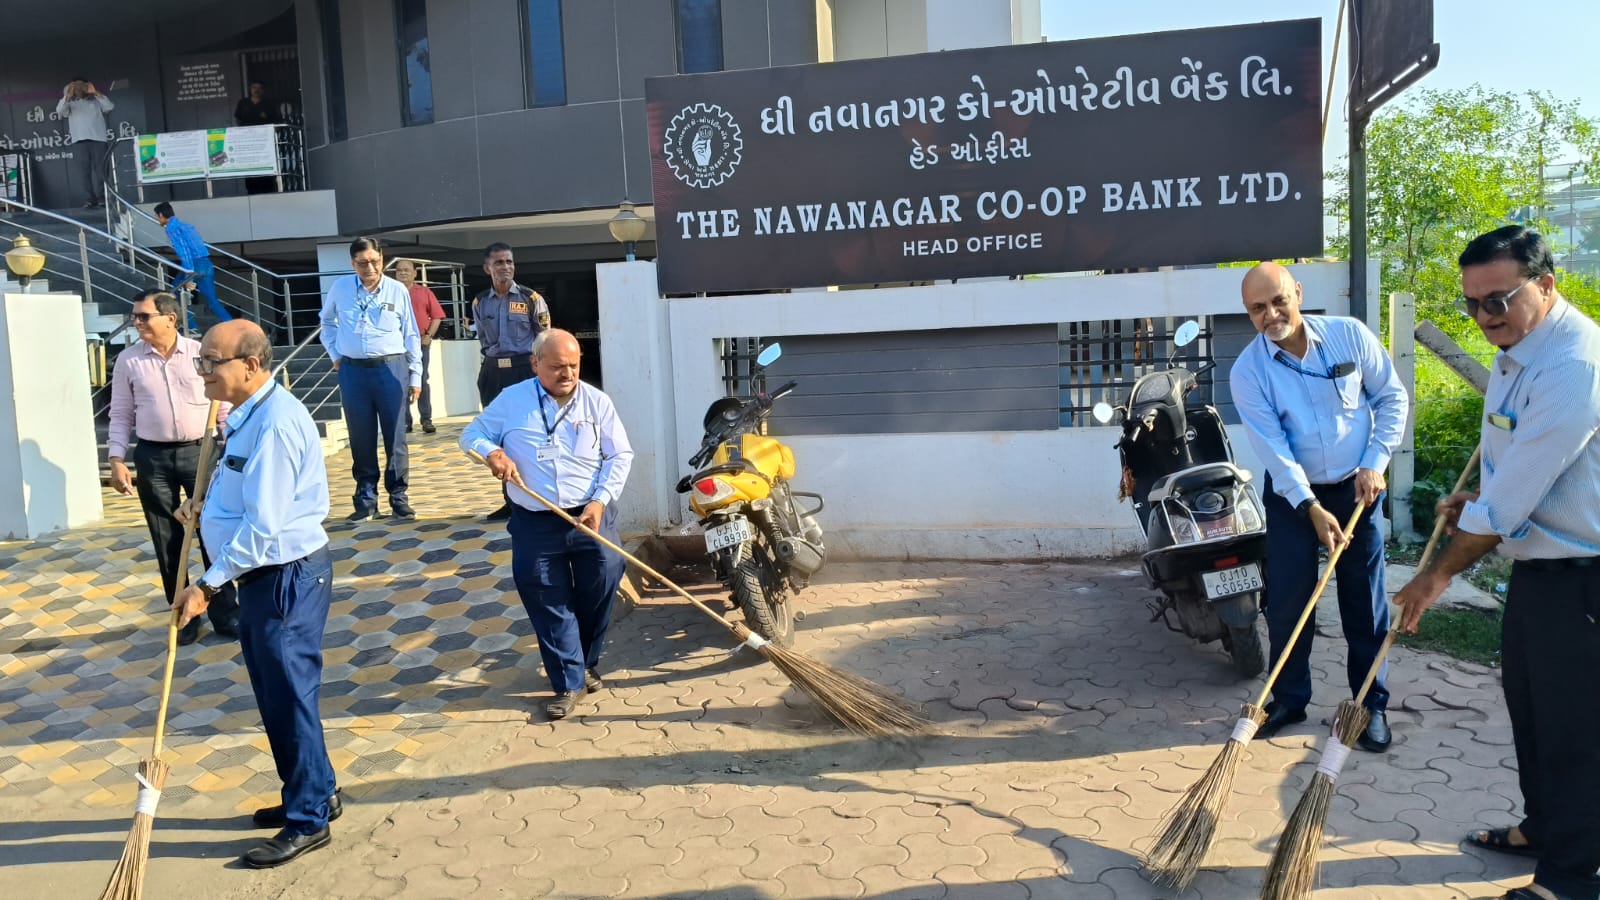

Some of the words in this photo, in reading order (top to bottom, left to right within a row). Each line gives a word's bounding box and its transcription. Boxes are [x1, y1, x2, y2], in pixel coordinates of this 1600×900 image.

[760, 95, 796, 135] ધી
[808, 94, 946, 133] નવાનગર
[957, 66, 1161, 121] કો-ઓપરેટીવ
[1171, 57, 1229, 101] બેંક
[1240, 55, 1292, 98] લિ.
[909, 137, 939, 170] હેડ
[951, 131, 1032, 162] ઓફીસ
[677, 209, 740, 239] THE
[754, 195, 962, 235] NAWANAGAR
[977, 185, 1087, 221] CO-OP
[1103, 177, 1202, 213] BANK
[1218, 172, 1302, 207] LTD.
[904, 239, 959, 256] HEAD
[966, 233, 1043, 252] OFFICE
[713, 530, 748, 549] CL9938
[1215, 577, 1258, 595] CS0556
[1219, 567, 1248, 583] GJ10
